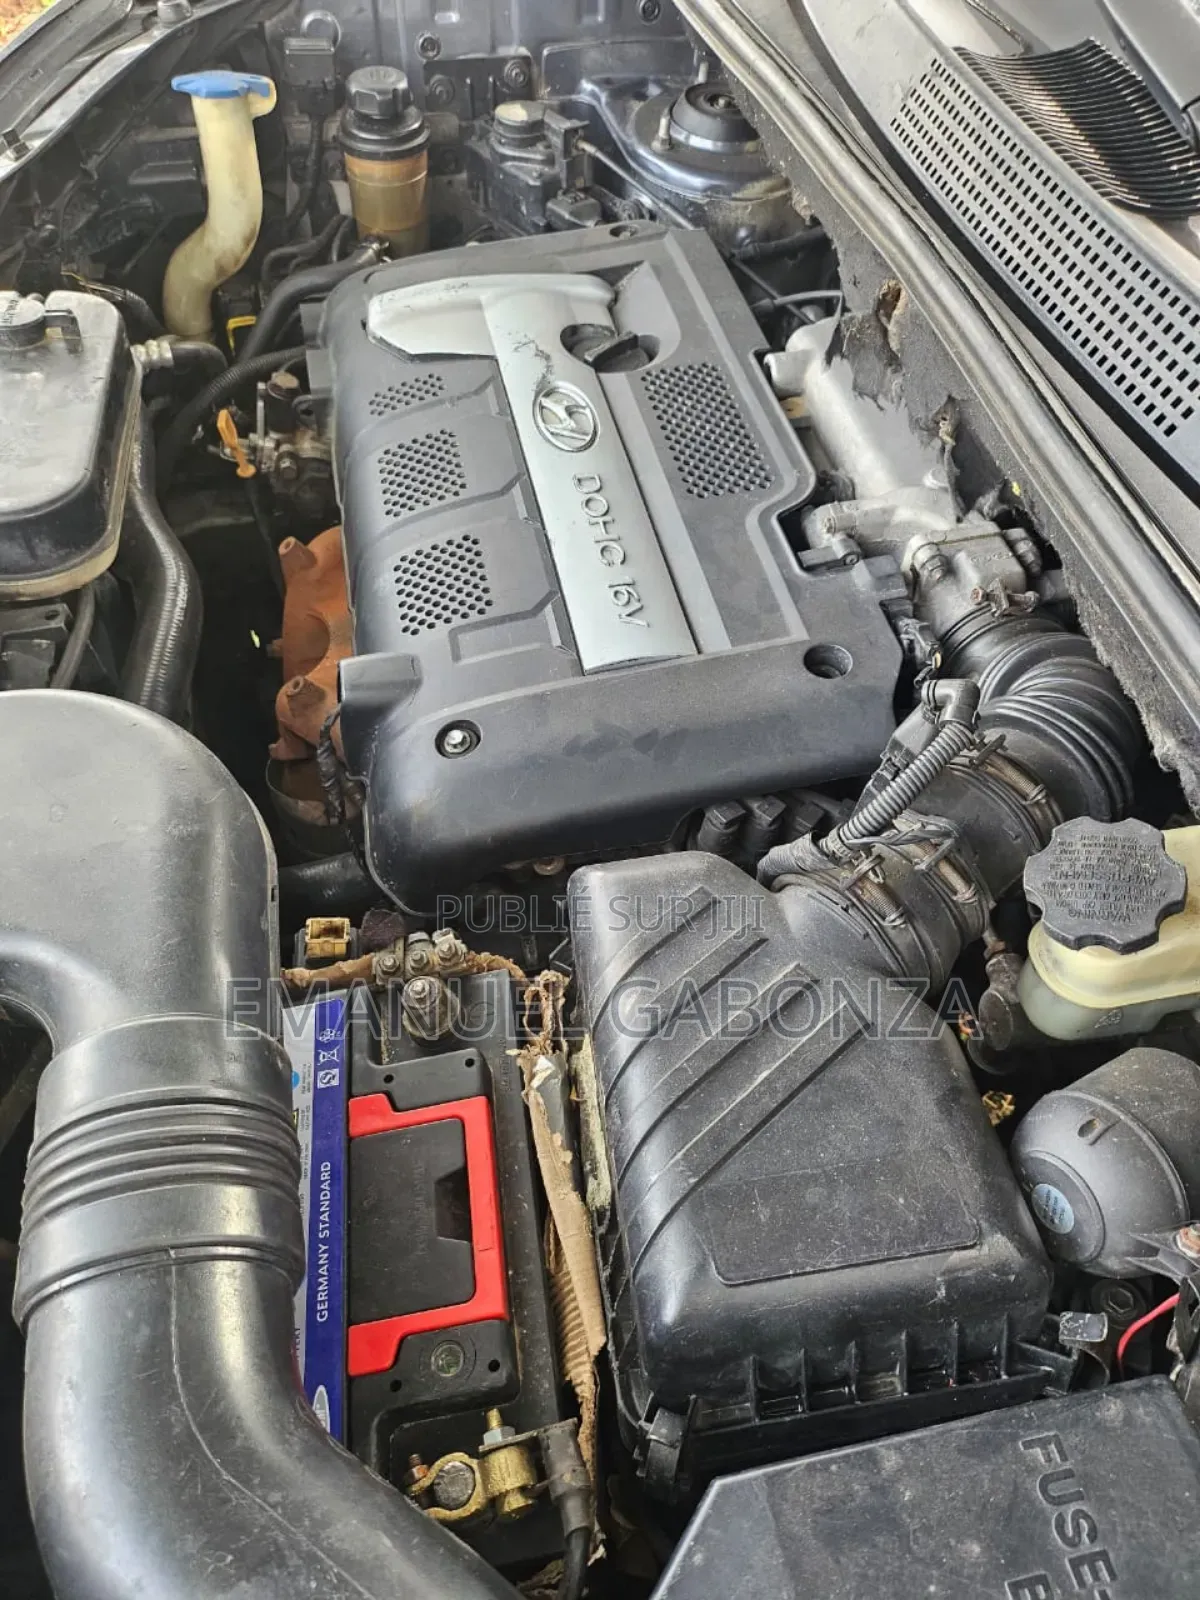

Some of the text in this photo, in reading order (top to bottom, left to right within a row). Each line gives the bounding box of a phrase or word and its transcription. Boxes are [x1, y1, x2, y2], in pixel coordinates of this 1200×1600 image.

[572, 473, 650, 628] DOHC 16V
[1068, 908, 1131, 923] WARNING
[316, 1161, 331, 1323] GERMANY STANDARD
